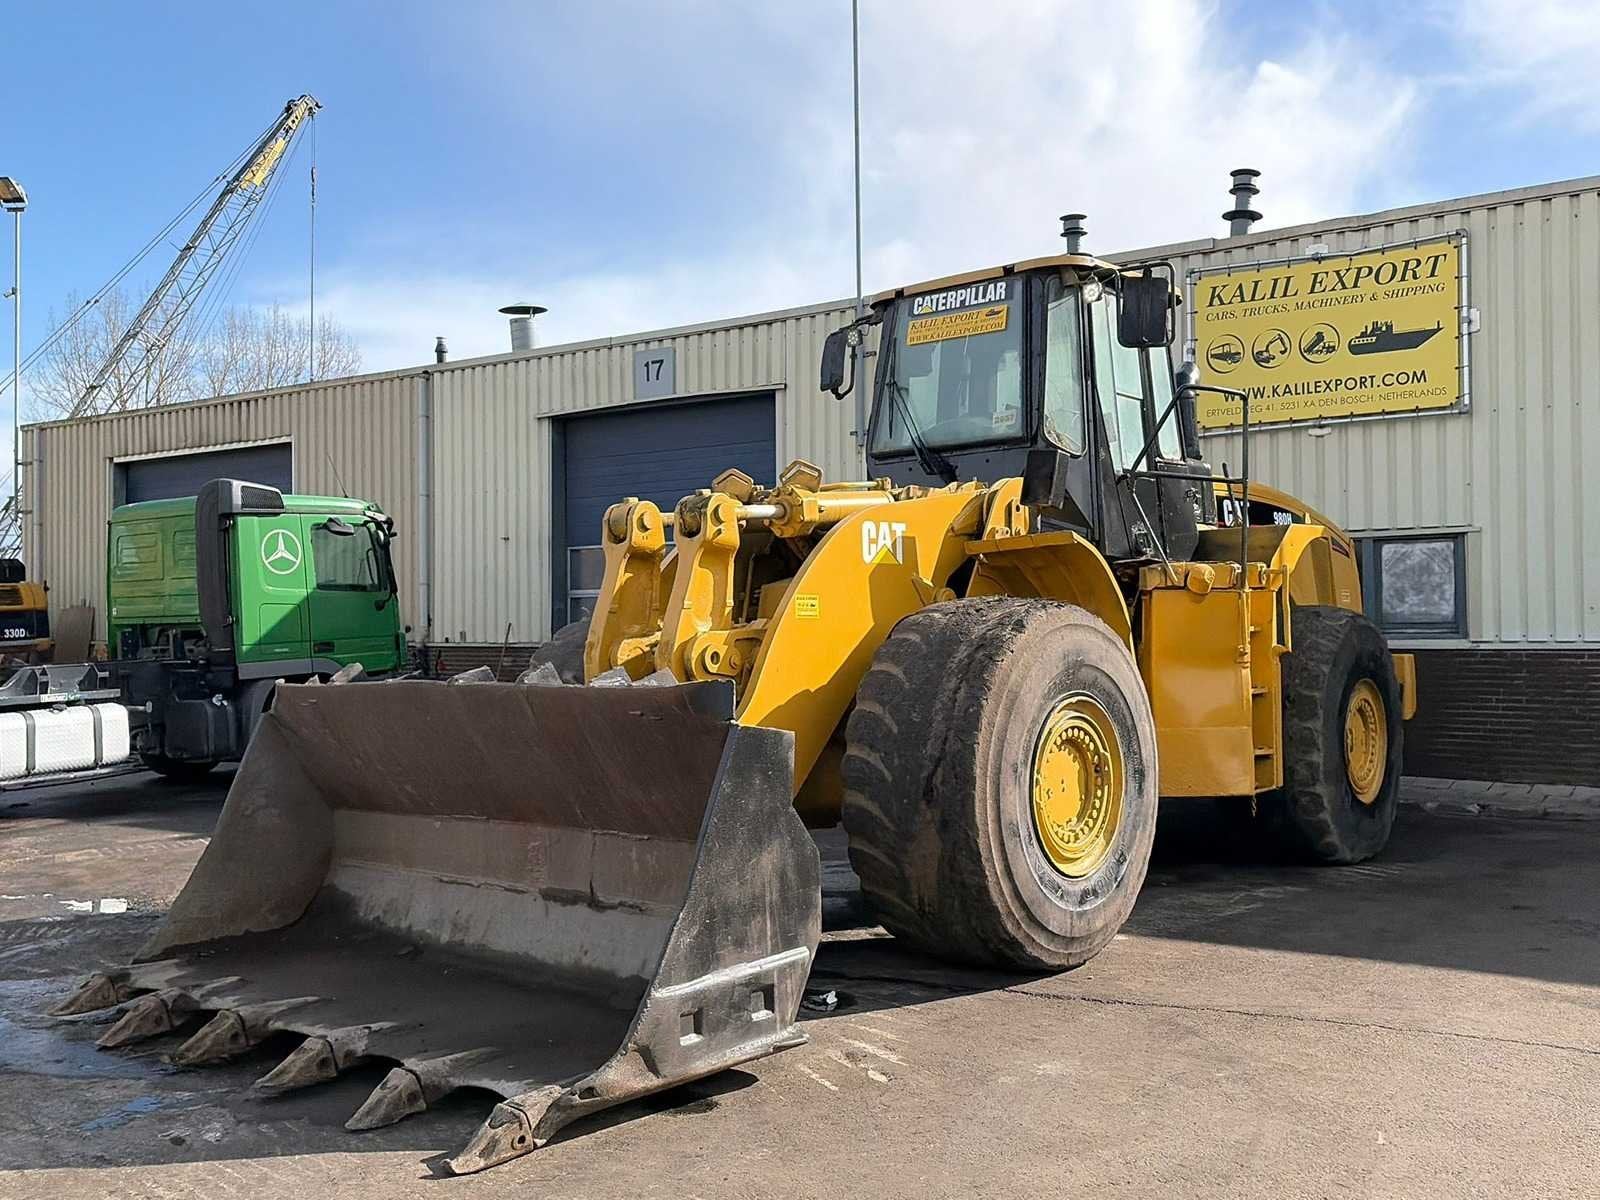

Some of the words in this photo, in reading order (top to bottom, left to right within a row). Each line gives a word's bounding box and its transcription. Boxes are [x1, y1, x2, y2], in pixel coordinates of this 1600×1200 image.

[1206, 275, 1299, 307] KALIL
[1307, 254, 1447, 294] EXPORT
[913, 281, 1007, 315] CATERPILLAR
[1205, 310, 1238, 322] CARS,
[1242, 303, 1290, 317] TRUCKS,
[1294, 293, 1366, 311] MACHINERY
[1369, 292, 1379, 302] &
[1382, 282, 1446, 300] SHIPPING
[911, 320, 939, 330] KALIL
[941, 311, 982, 325] EXPORT
[644, 358, 665, 382] 17
[1206, 404, 1263, 417] ERTVELDEG
[1279, 400, 1300, 411] 5231
[1302, 399, 1316, 409] XA
[1317, 397, 1338, 408] DEN
[1378, 386, 1448, 401] NETHERLANDS
[861, 520, 906, 566] CAT
[4, 628, 26, 639] 330D
